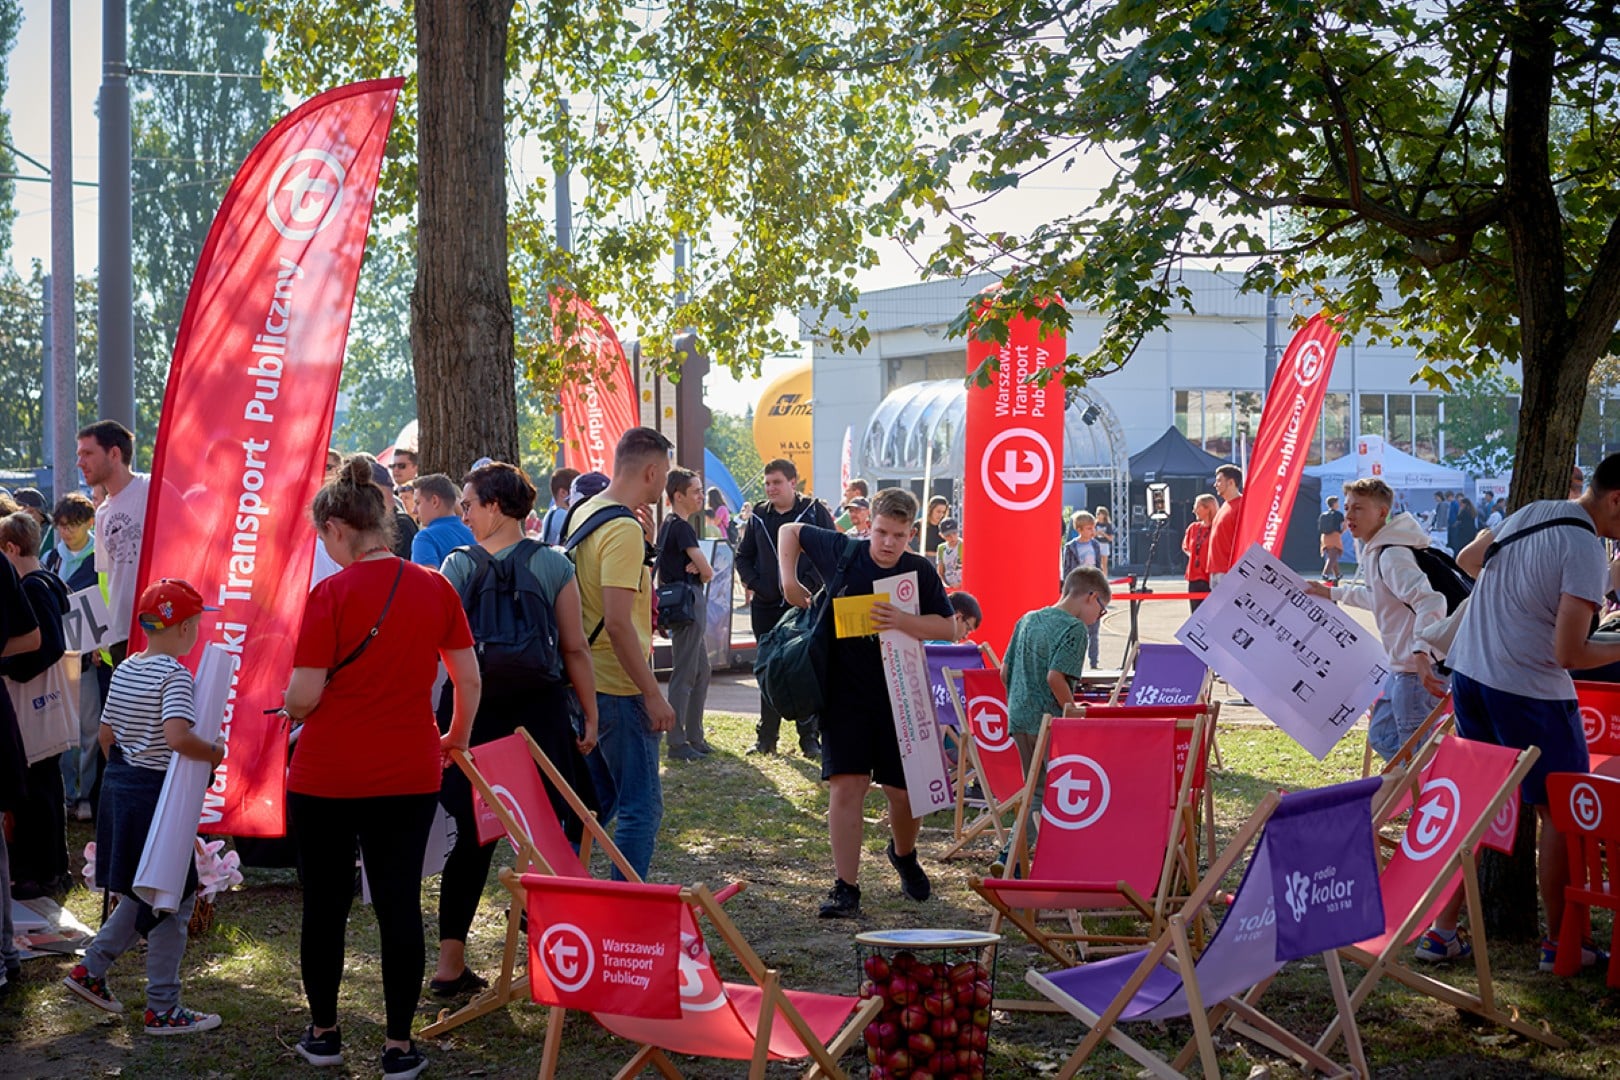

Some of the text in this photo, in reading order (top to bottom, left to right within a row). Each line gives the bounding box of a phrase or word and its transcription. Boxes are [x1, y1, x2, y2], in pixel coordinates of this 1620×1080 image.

[995, 328, 1012, 418] Warszaws
[1012, 345, 1030, 417] Transport
[218, 437, 270, 606] Transport
[244, 257, 304, 423] Publiczny
[1277, 393, 1306, 478] Publiczny
[780, 441, 810, 449] HALO
[1157, 693, 1192, 704] kolor
[929, 779, 946, 805] 03
[1314, 865, 1337, 881] radio
[1311, 878, 1355, 905] kolor
[1340, 899, 1352, 910] FM
[602, 939, 665, 957] Warszawski
[602, 954, 653, 971] Transport
[602, 970, 650, 991] Publiczny
